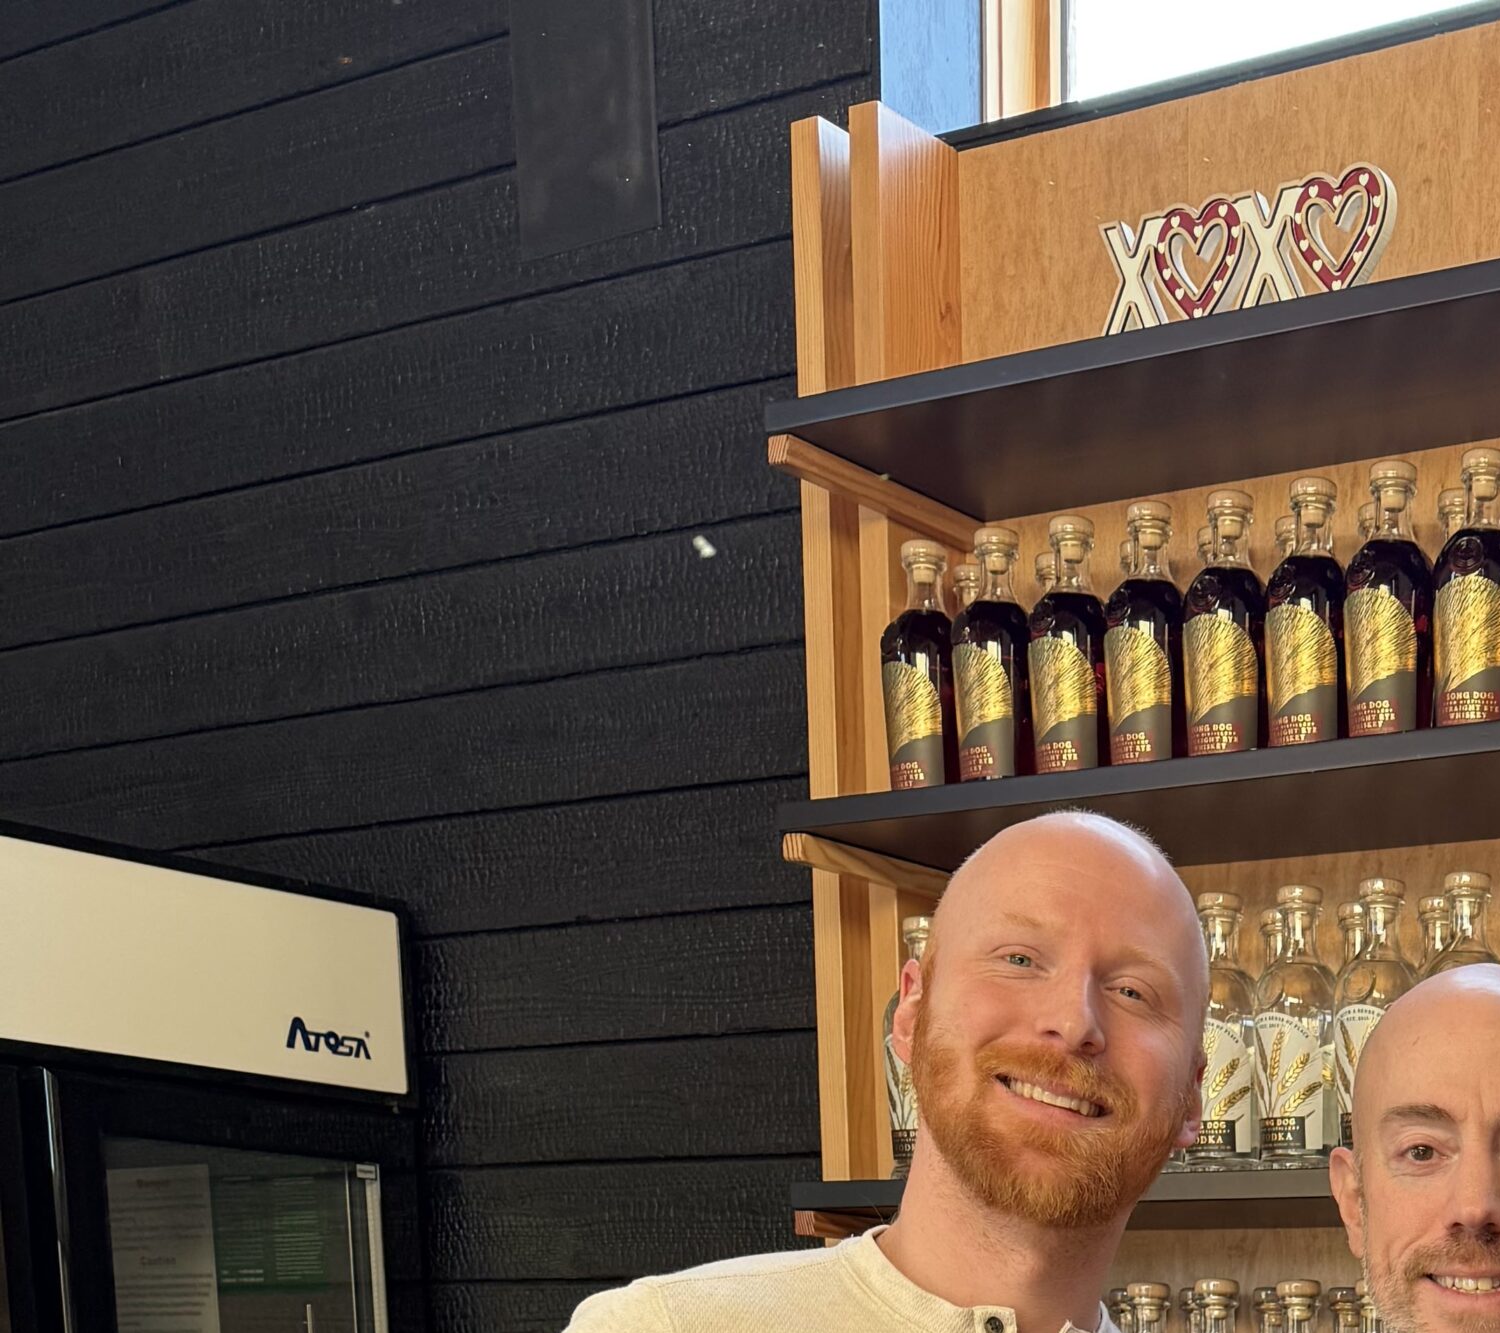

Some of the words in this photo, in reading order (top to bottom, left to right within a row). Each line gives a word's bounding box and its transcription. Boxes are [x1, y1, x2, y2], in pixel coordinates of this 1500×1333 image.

[1447, 690, 1469, 701] SONG
[1473, 690, 1495, 700] DOG
[1369, 700, 1390, 709] DOG
[1291, 713, 1312, 723] DOG
[1212, 723, 1233, 732] DOG
[1126, 731, 1146, 740] DOG
[1053, 740, 1072, 750] DOG
[1206, 1121, 1227, 1130] DOG
[1276, 1117, 1296, 1127] DOG
